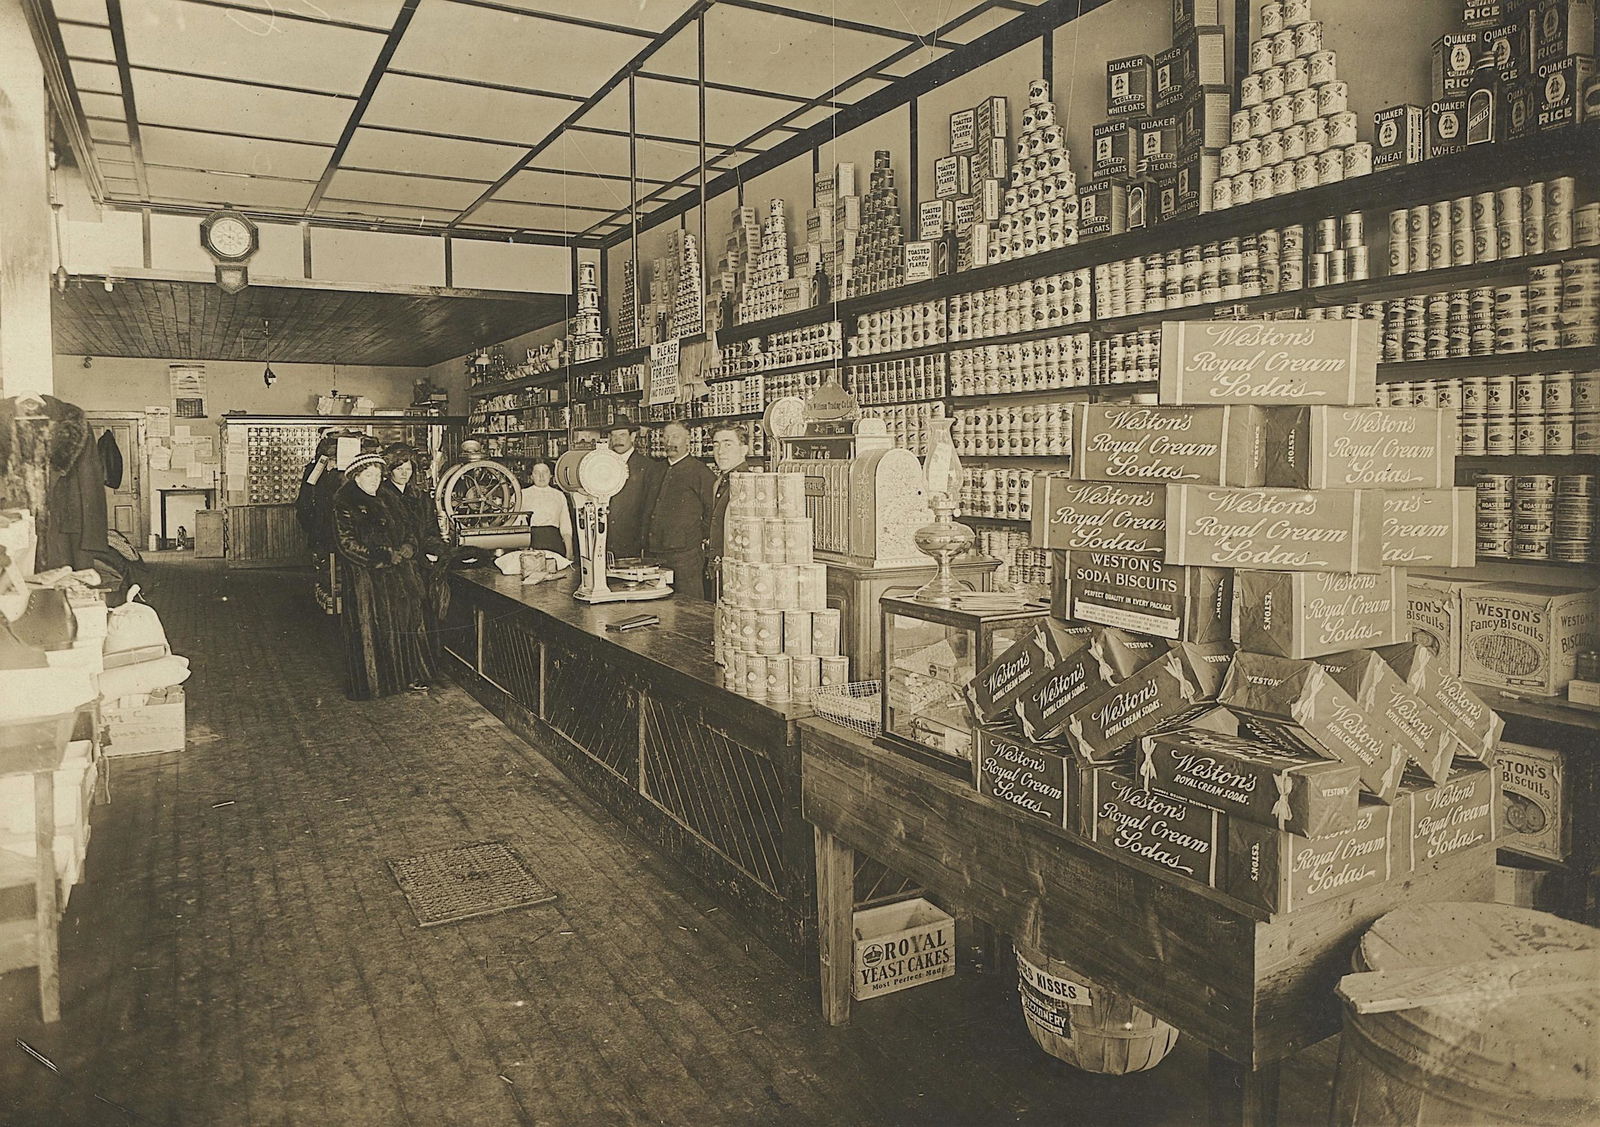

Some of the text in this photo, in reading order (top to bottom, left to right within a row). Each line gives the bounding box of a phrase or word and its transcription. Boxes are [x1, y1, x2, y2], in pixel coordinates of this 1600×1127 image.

[1464, 7, 1500, 20] RICE
[1444, 34, 1477, 46] QUAKER
[1484, 24, 1517, 42] QUAKER
[1109, 59, 1143, 72] QUAKER
[1156, 49, 1181, 65] QUAKER
[1538, 58, 1573, 78] QUAKER
[1445, 77, 1474, 89] RIC
[1501, 69, 1518, 81] CE
[1128, 102, 1146, 113] OATS
[1374, 108, 1404, 124] QUAKER
[1432, 102, 1465, 114] QUAKER
[1538, 107, 1572, 125] RICE
[1094, 122, 1126, 136] QUAKER
[1141, 118, 1176, 130] QUAKER
[1373, 152, 1403, 166] WHEAT
[1432, 144, 1466, 156] WHEAT
[1110, 164, 1127, 174] OATS
[1080, 182, 1108, 194] QUAKER
[957, 204, 974, 212] TOAST
[1094, 224, 1110, 233] OATS
[1207, 326, 1317, 348] Weston's
[657, 344, 678, 357] PLEASE
[1186, 351, 1346, 380] Royal Cream
[1210, 374, 1328, 398] Sodas
[1105, 408, 1193, 432] Weston's
[1343, 410, 1416, 434] Weston's
[1087, 433, 1217, 462] Royal Cream
[1328, 436, 1435, 465] Royal Cream
[1106, 456, 1201, 480] Sodas
[1345, 461, 1424, 484] Sodas
[1067, 485, 1154, 507] Weston's
[1208, 491, 1318, 516] Weston's
[1050, 506, 1114, 533] Royal
[1070, 528, 1163, 552] Sodas
[1188, 518, 1348, 547] Royal Cream
[1091, 552, 1162, 573] WESTON'S
[1211, 542, 1328, 568] Sodas
[1077, 568, 1178, 593] SODA BISCUITS
[1317, 572, 1376, 592] Weston's
[1084, 589, 1104, 598] PERFECT
[1104, 592, 1124, 602] QUALITY
[1132, 598, 1150, 608] EVERY
[1306, 592, 1390, 628] Royal Cream
[1407, 600, 1442, 614] TON'S
[1264, 592, 1272, 630] ESTON'S
[1476, 602, 1542, 624] WESTON'S
[1320, 620, 1383, 644] Sodas
[1470, 618, 1544, 643] Fancy Biscuits
[983, 650, 1030, 694] Weston's
[1032, 662, 1085, 710] Weston's
[1436, 667, 1482, 720] Weston's
[1092, 679, 1158, 729] Weston's
[1388, 683, 1434, 740] Weston's
[1105, 722, 1123, 740] ROYAL
[1122, 710, 1142, 728] CREAM
[1331, 696, 1384, 756] Weston's
[1326, 722, 1345, 740] ROYAL
[1343, 737, 1361, 754] CREAM
[990, 738, 1046, 772] Weston's
[982, 756, 1062, 800] Royal Cream
[1171, 750, 1257, 792] Weston's
[1496, 758, 1547, 780] STON'S
[1174, 774, 1198, 790] ROYAL
[1198, 782, 1224, 796] CREAM
[1222, 790, 1250, 806] SODAS.
[1425, 779, 1476, 810] Weston's
[1502, 770, 1550, 800] Biscuits
[993, 780, 1052, 818] Sodas
[1111, 781, 1187, 822] Weston's
[1099, 802, 1209, 853] Royal Cream
[1414, 803, 1491, 845] Royal Cream
[1114, 829, 1194, 875] Sodas
[1427, 830, 1484, 859] Sodas
[1251, 842, 1260, 881] ESTON'S
[1293, 837, 1386, 878] Royal Cream
[1307, 862, 1376, 894] Sodas
[884, 930, 946, 960] ROYAL
[861, 948, 950, 986] YEAST CAKES
[872, 982, 890, 991] Most
[894, 974, 922, 986] Perfect
[1036, 972, 1077, 999] KISSES
